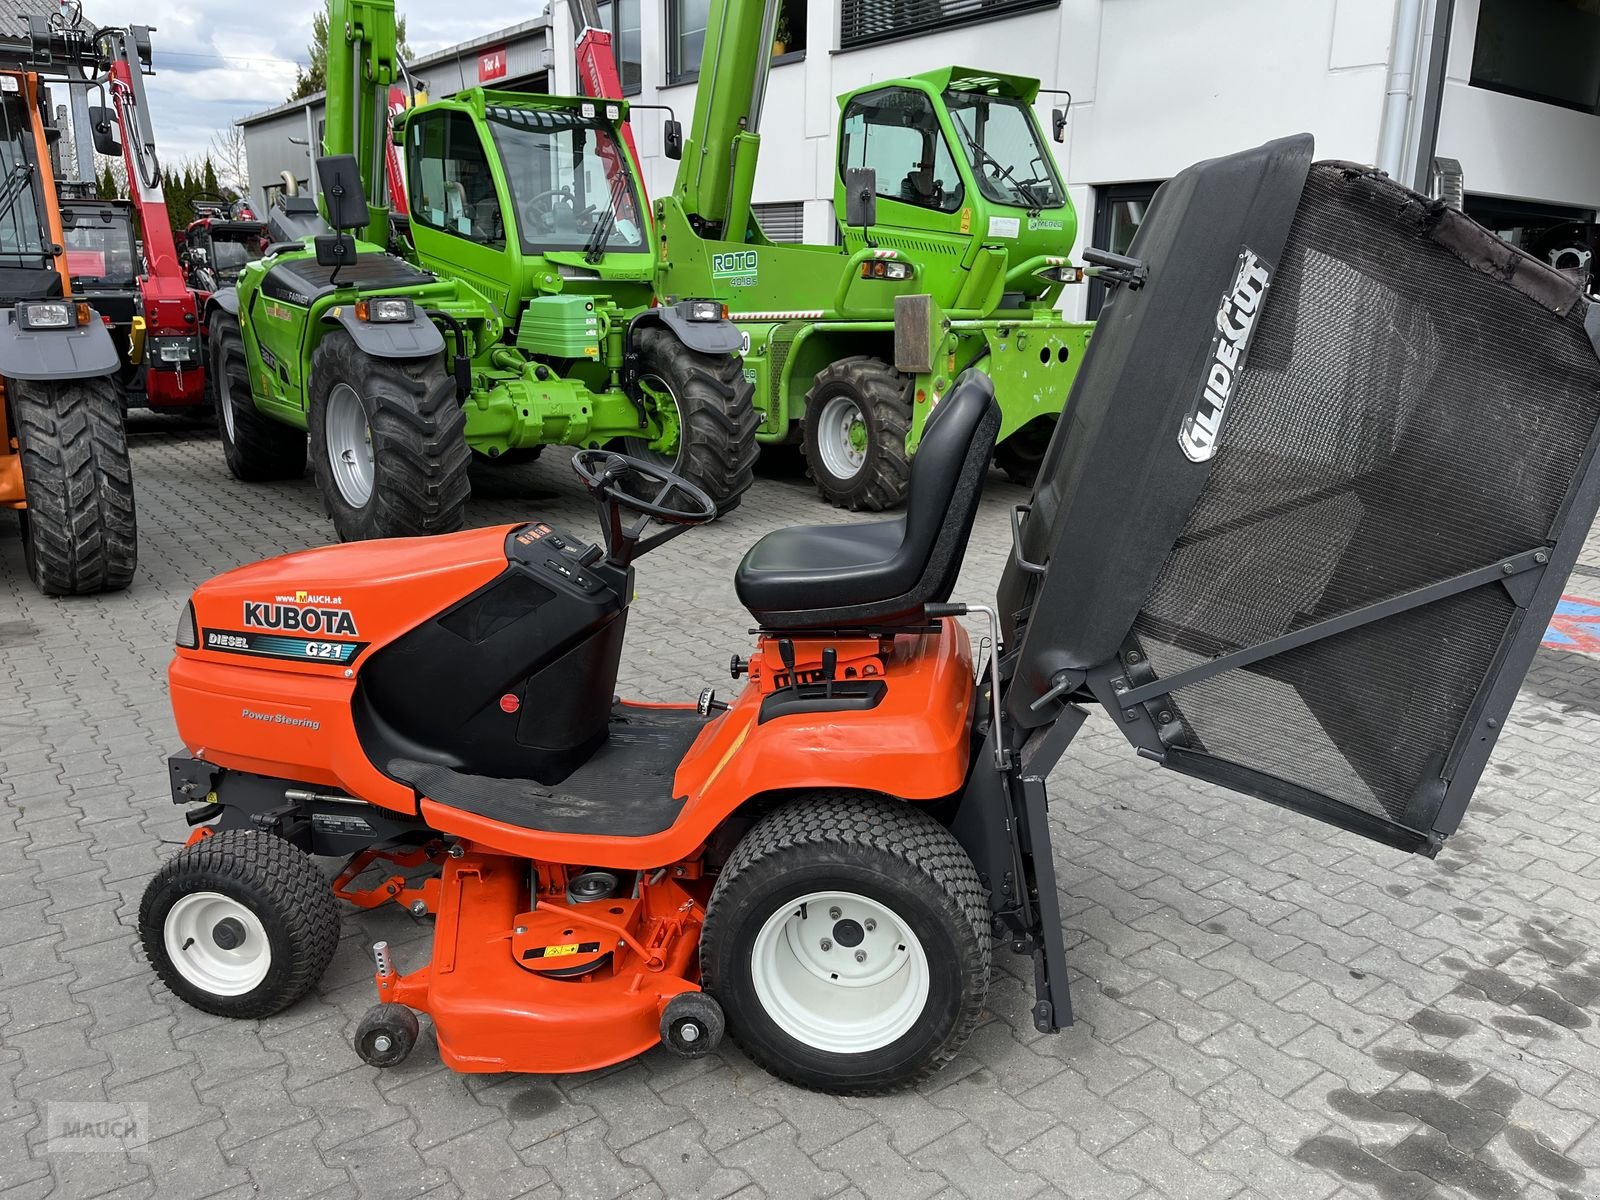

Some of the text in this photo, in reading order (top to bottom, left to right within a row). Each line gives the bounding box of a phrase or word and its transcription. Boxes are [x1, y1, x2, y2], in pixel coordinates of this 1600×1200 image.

[483, 55, 501, 72] Tor A
[713, 250, 758, 272] ROTO
[275, 593, 342, 605] www.MAUCH.at
[244, 602, 358, 635] KUBOTA
[208, 632, 343, 659] DIESEL G21
